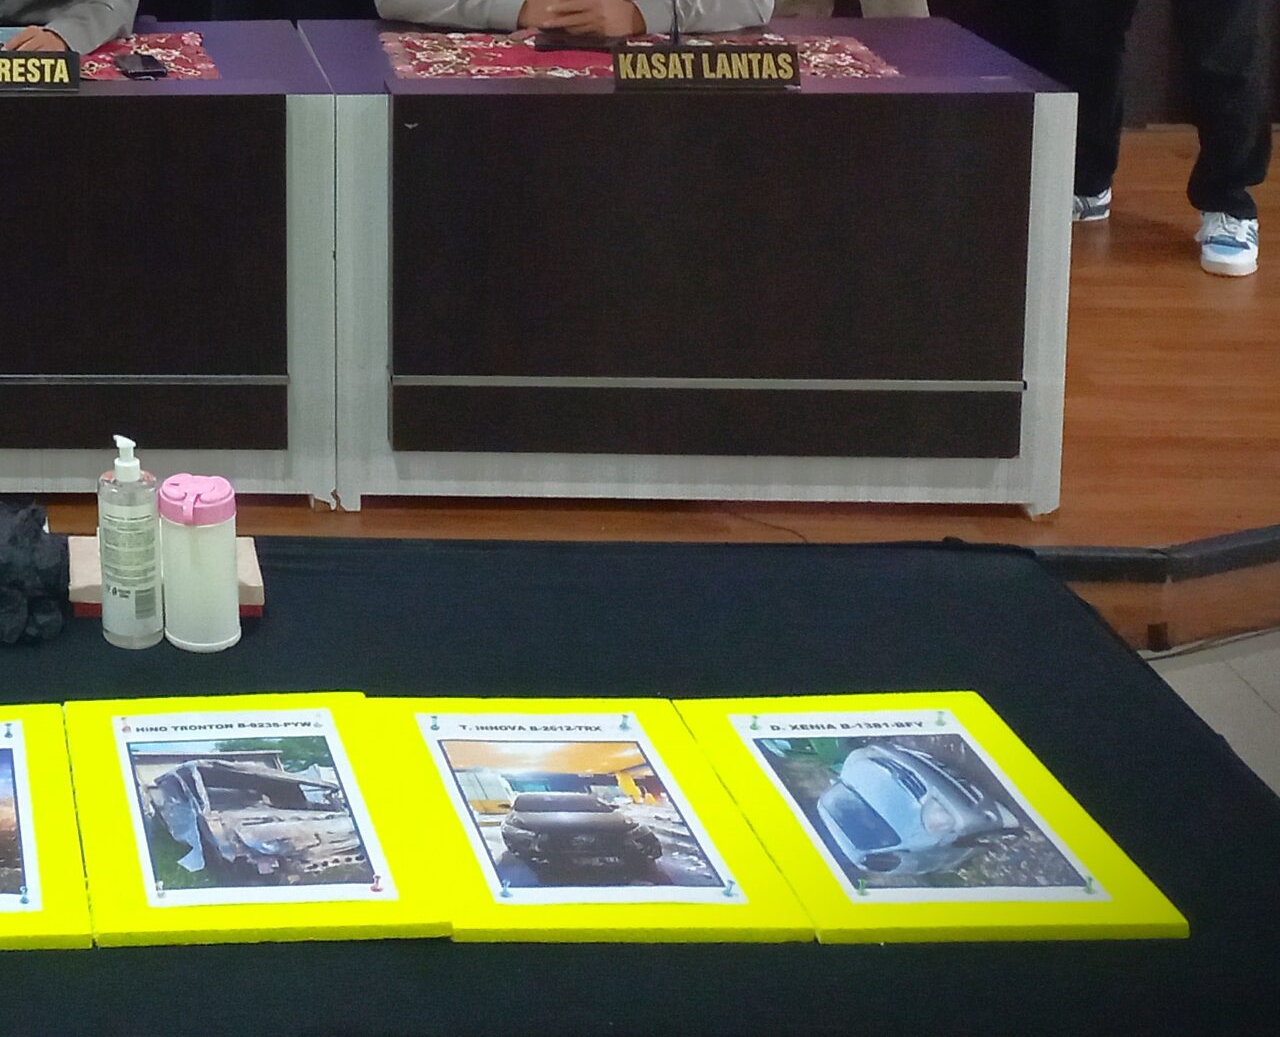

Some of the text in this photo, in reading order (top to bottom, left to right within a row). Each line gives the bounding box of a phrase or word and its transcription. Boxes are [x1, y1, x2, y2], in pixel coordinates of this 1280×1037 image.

[619, 51, 794, 80] KASAT LANTAS
[788, 723, 837, 731] XENIA
